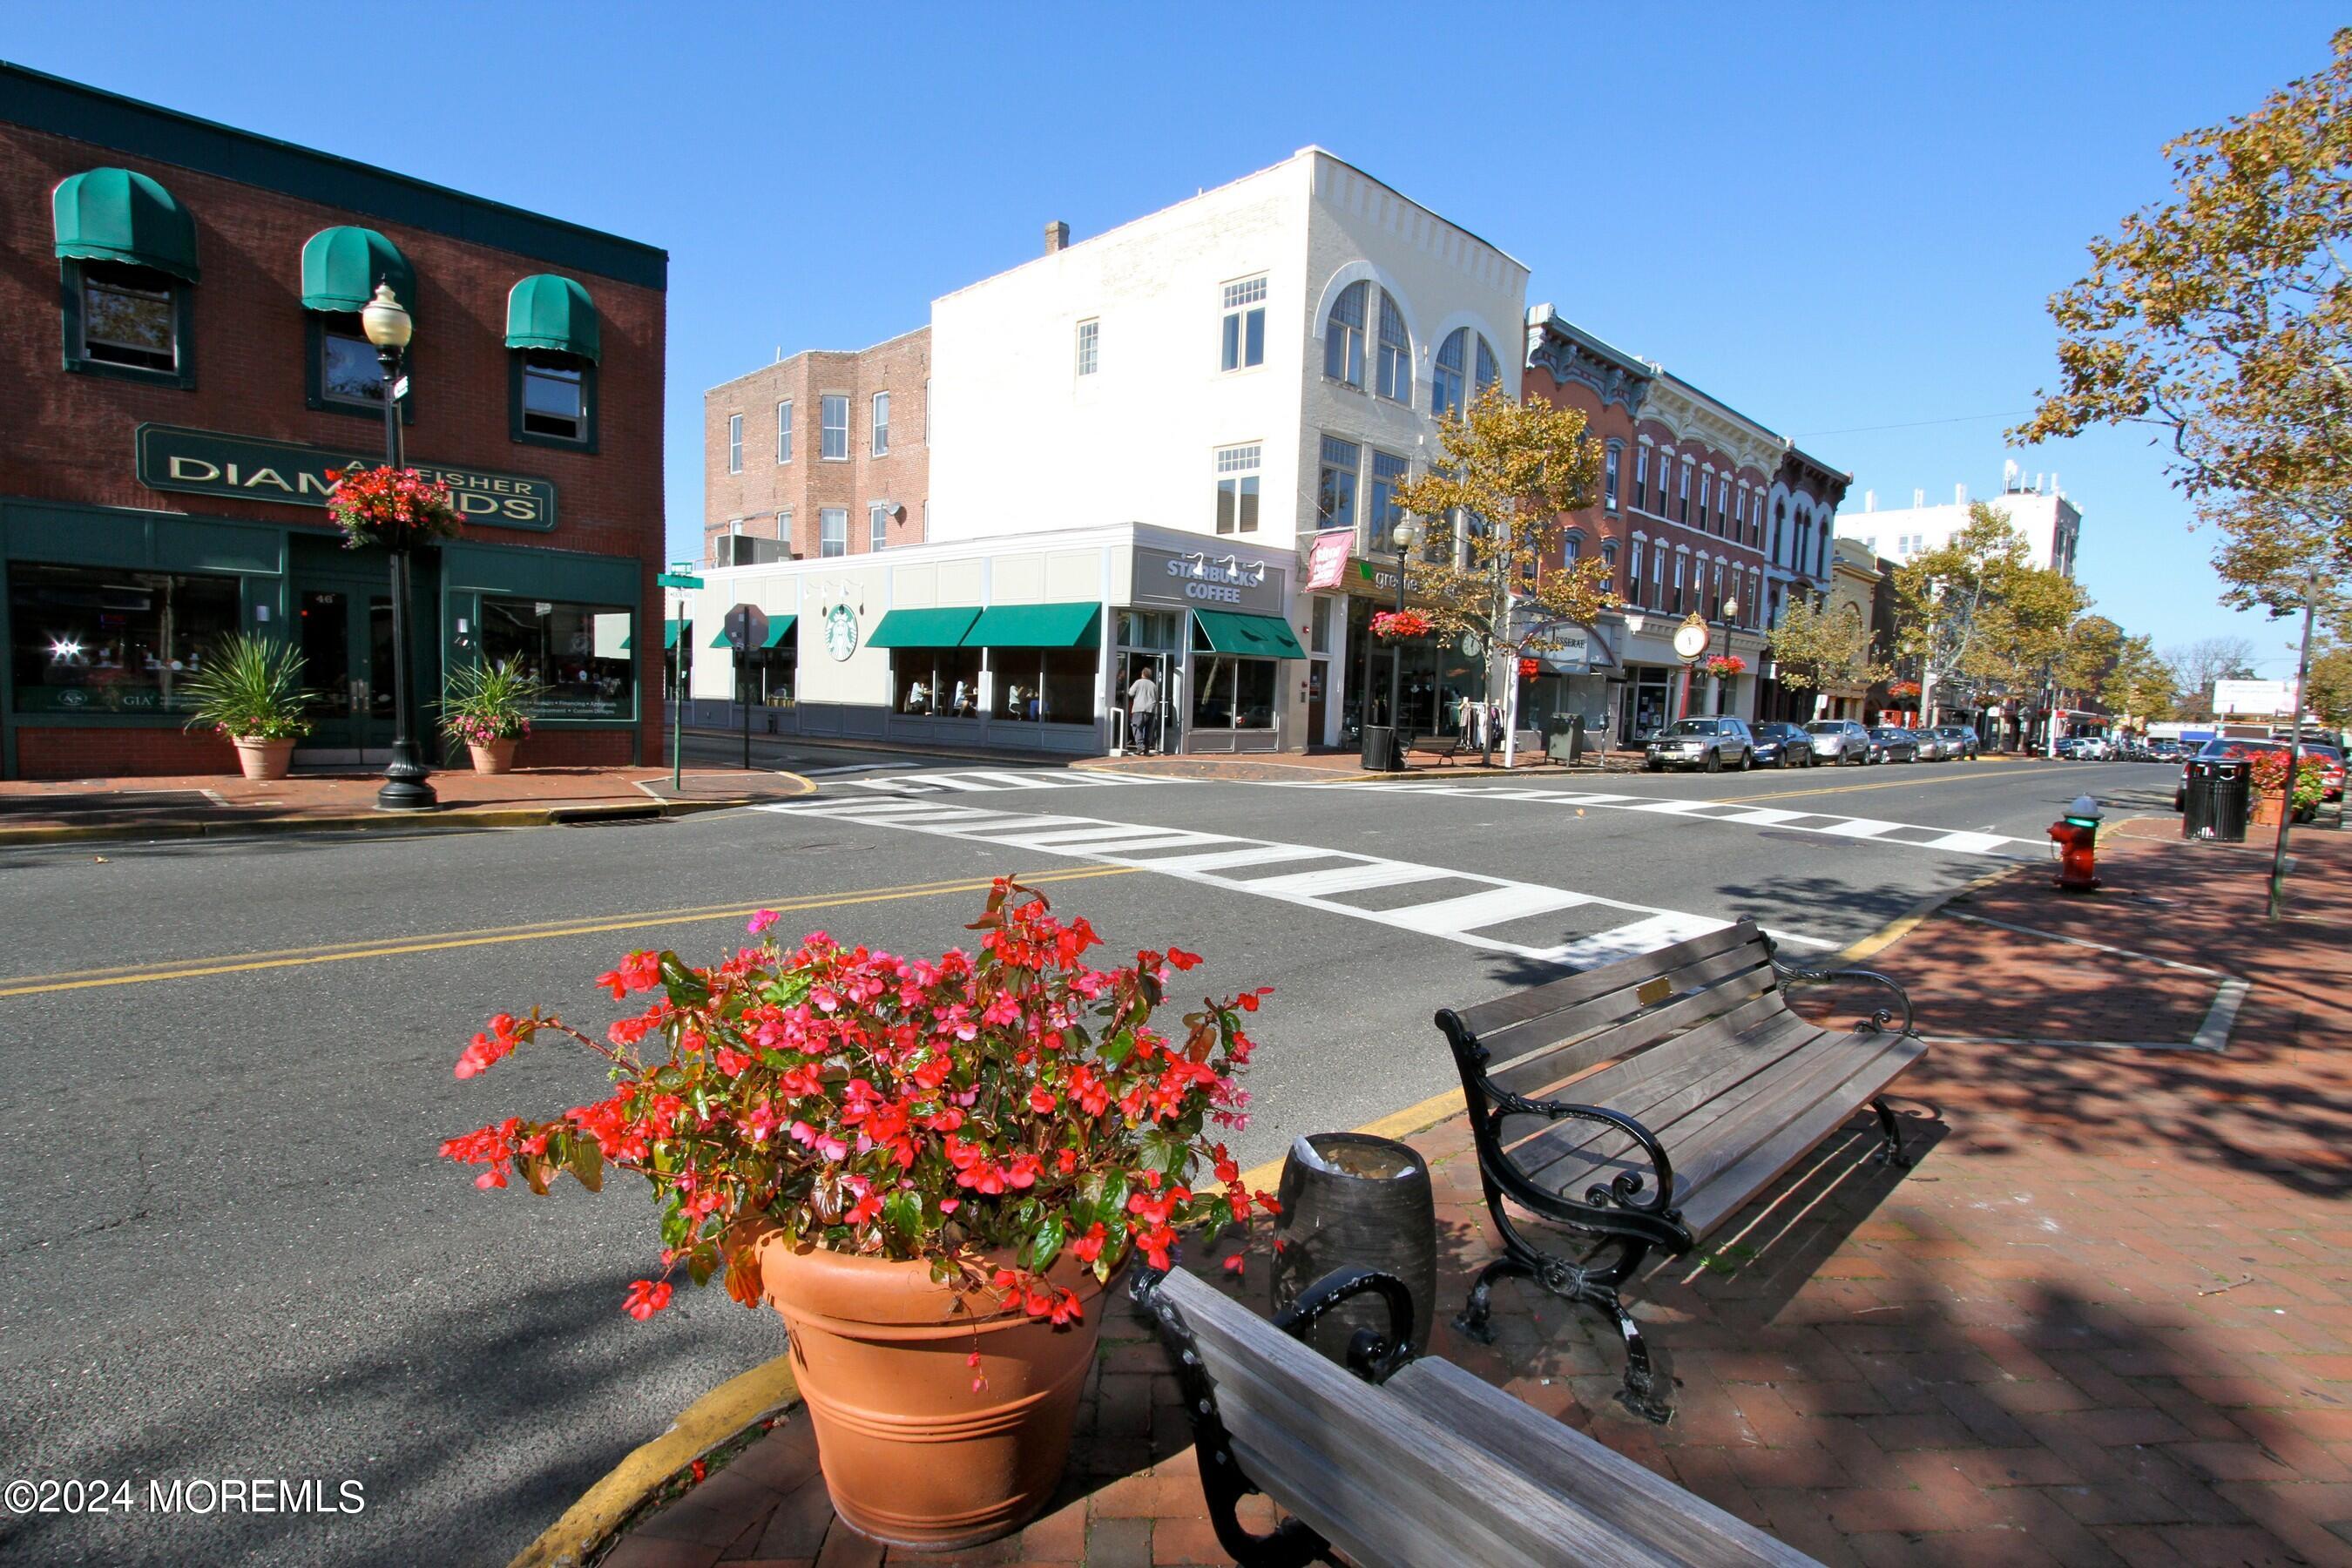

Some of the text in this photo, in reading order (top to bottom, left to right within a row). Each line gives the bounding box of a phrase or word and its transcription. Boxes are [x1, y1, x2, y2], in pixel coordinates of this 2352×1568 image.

[170, 456, 537, 521] DIAMDS
[416, 469, 533, 495] FISHER
[1166, 559, 1259, 589] STARBUCKS
[315, 594, 334, 605] 46
[1185, 582, 1241, 604] COFFEE
